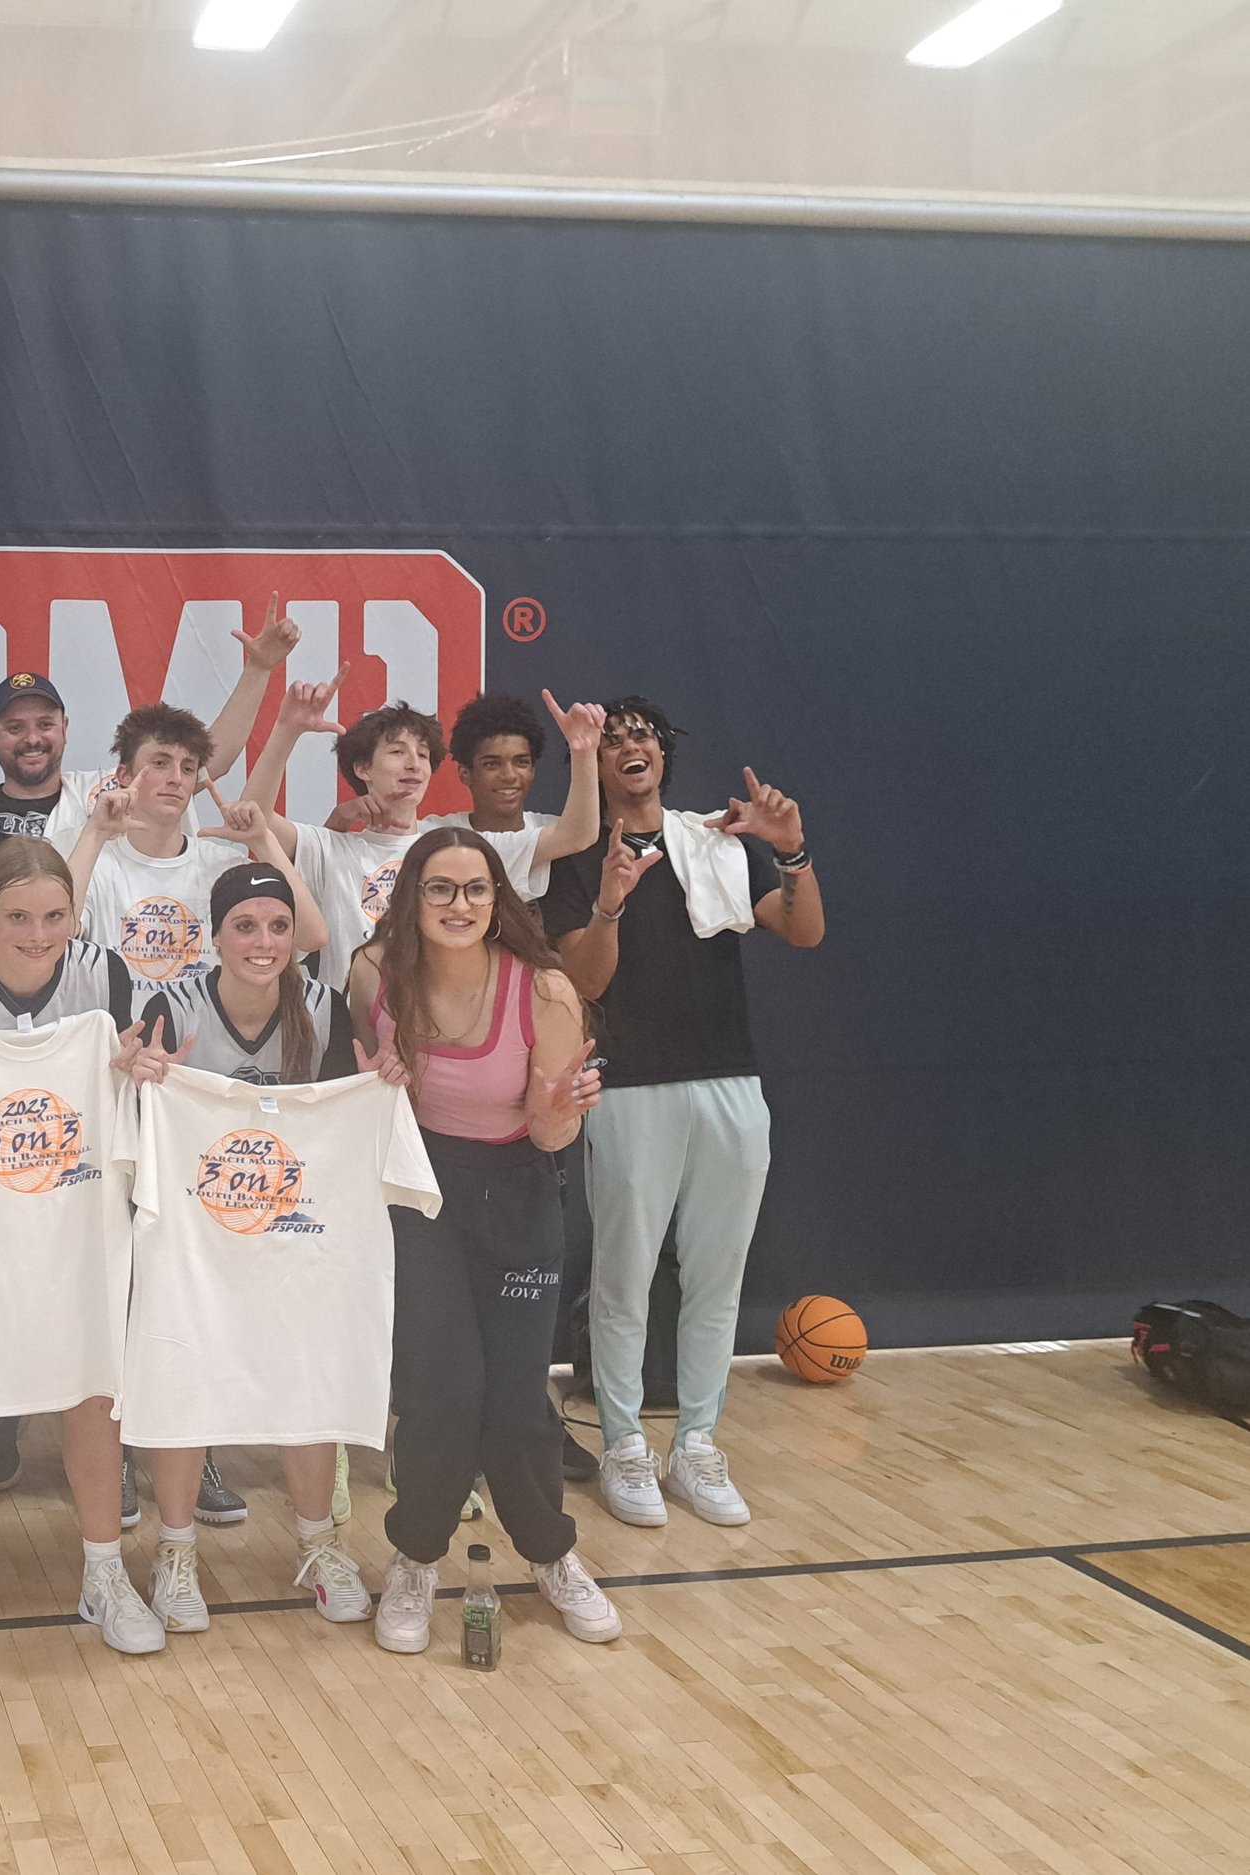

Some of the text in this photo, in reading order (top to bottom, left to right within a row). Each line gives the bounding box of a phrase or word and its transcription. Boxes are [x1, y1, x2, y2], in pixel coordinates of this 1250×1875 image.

[139, 904, 178, 919] 2025
[122, 922, 200, 947] 3 on 3
[2, 1097, 51, 1118] 2025
[27, 1112, 83, 1124] MADNESS
[12, 1131, 52, 1153] on
[60, 1119, 79, 1149] 3
[21, 1146, 92, 1160] BASKETBALL
[225, 1139, 275, 1160] 2025
[11, 1159, 63, 1170] LEAGUE
[199, 1154, 306, 1167] MARCH MADNESS
[199, 1162, 301, 1195] 3 on 3
[186, 1188, 315, 1204] YOUTH BASKETBALL
[225, 1200, 276, 1210] LEAGUE
[500, 1286, 542, 1300] LOVE
